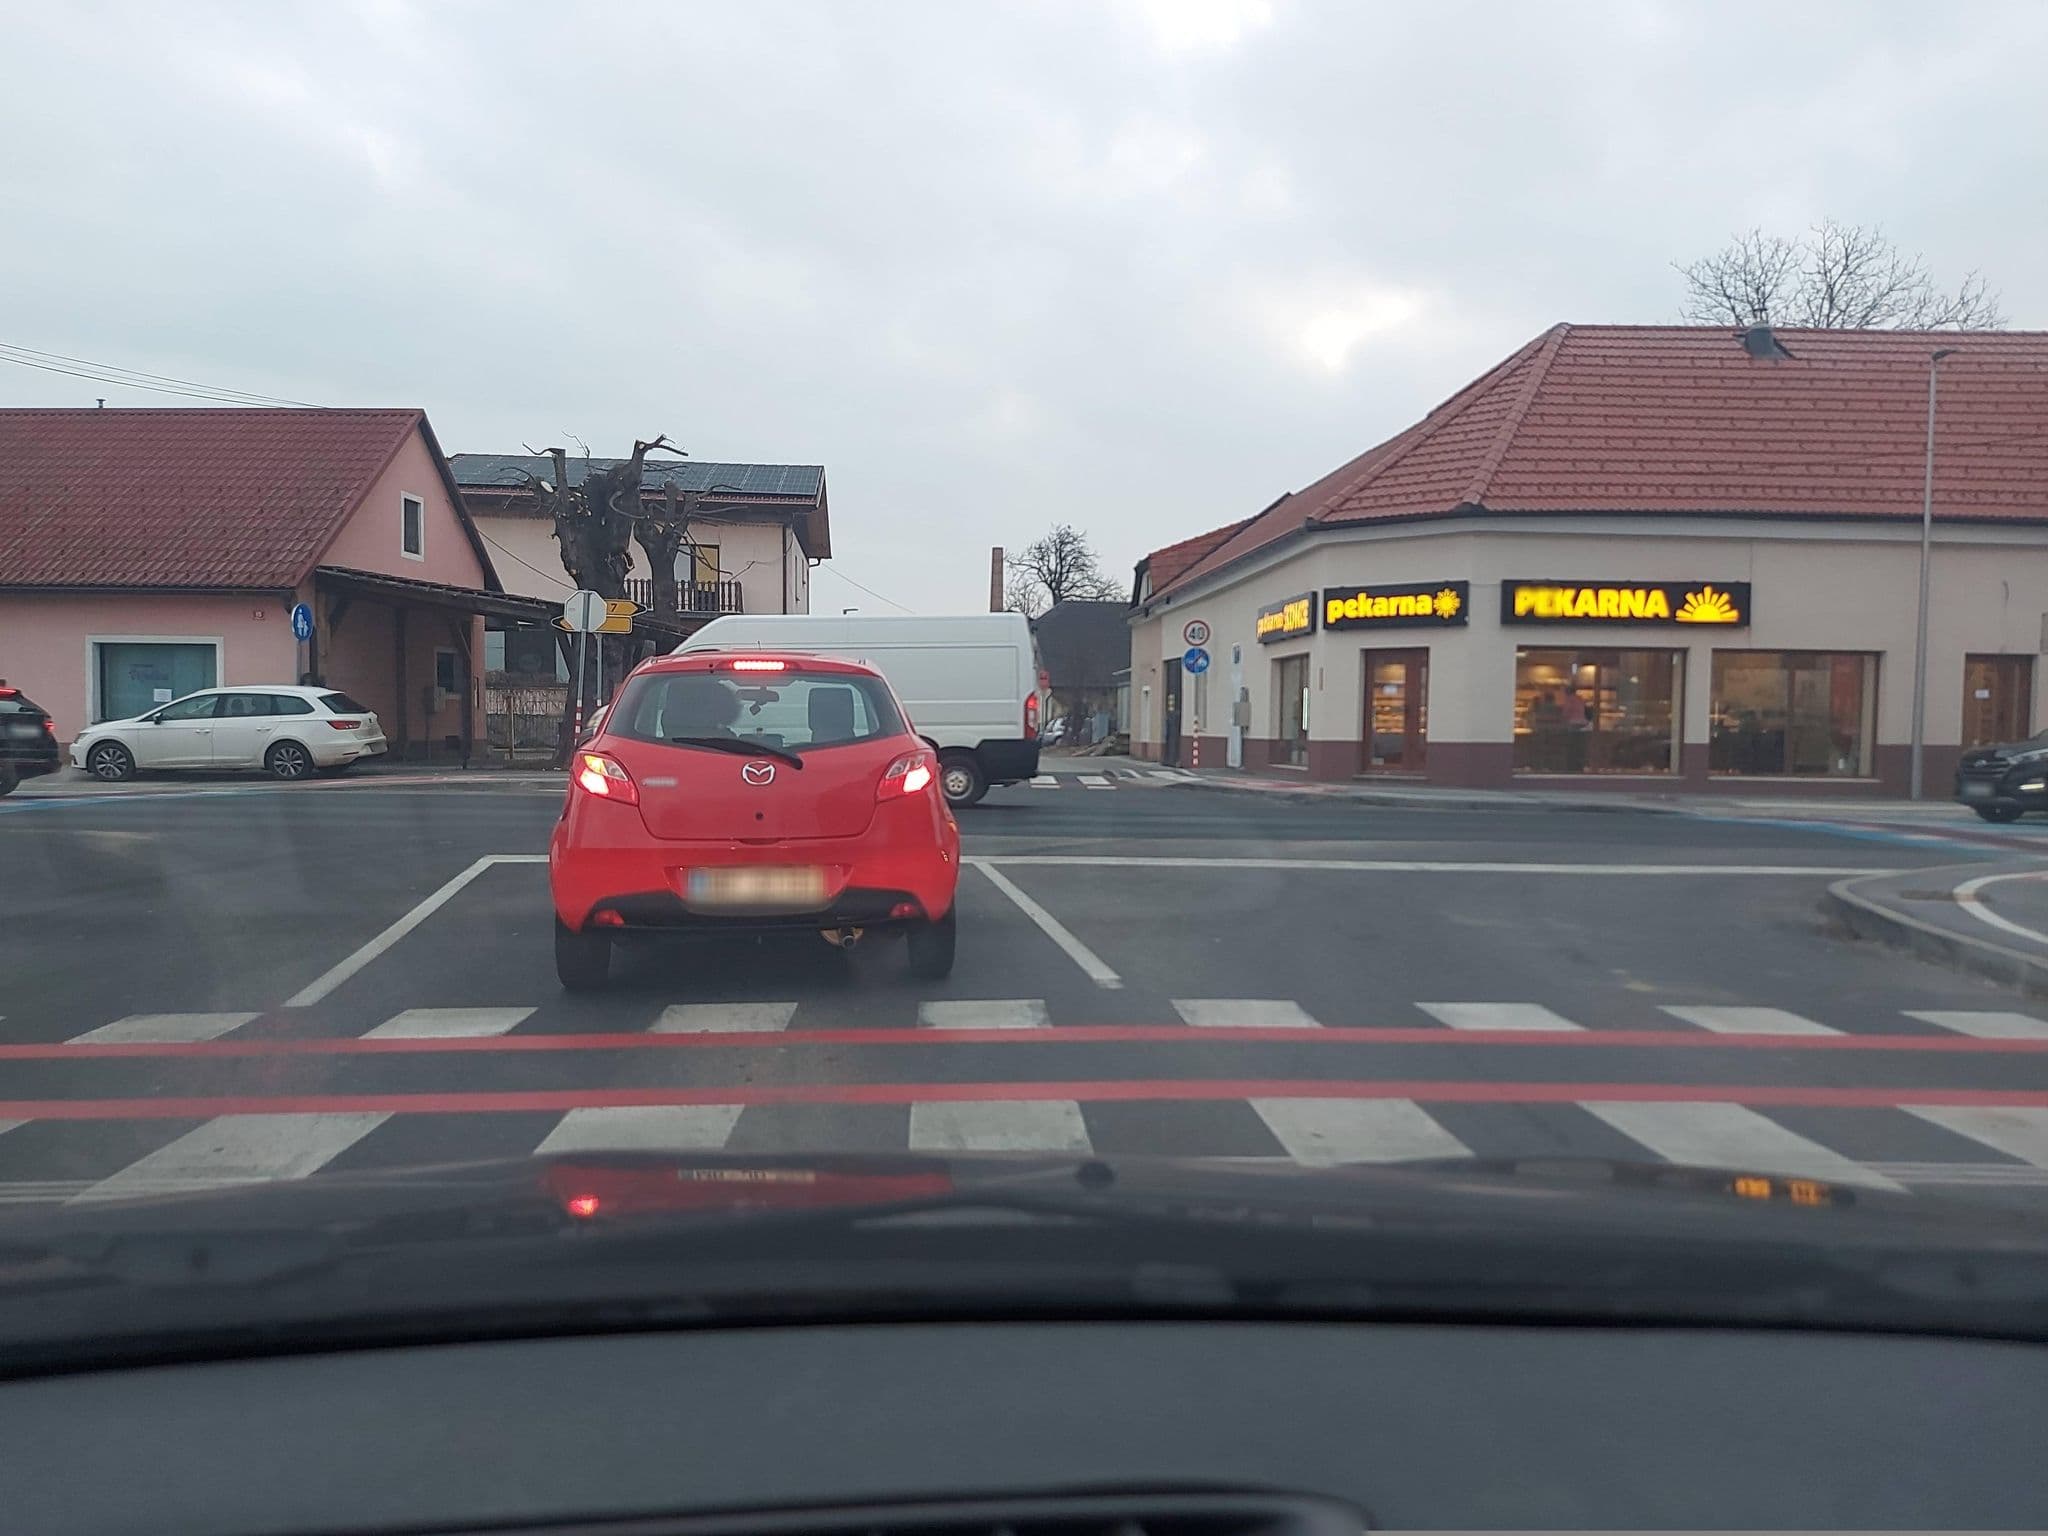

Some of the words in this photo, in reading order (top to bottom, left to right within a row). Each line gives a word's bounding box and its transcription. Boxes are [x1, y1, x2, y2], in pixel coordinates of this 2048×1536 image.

[610, 603, 617, 612] 7
[1327, 593, 1433, 624] pekarna
[1514, 586, 1670, 618] PEKARNA
[1189, 626, 1205, 640] 40
